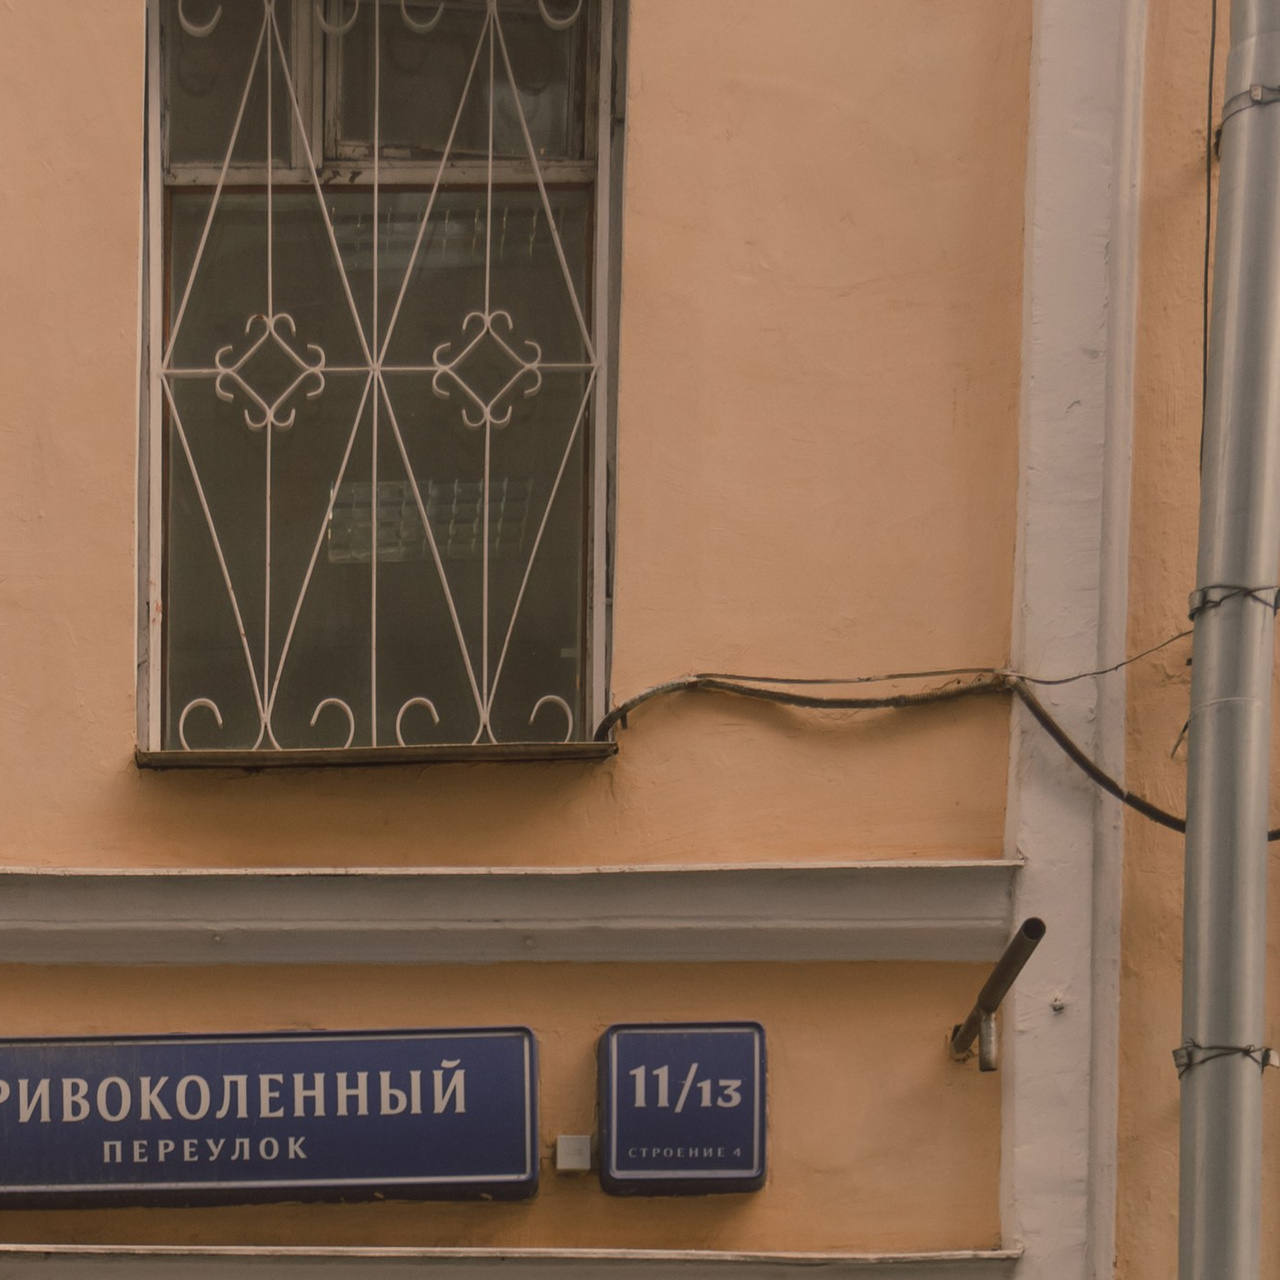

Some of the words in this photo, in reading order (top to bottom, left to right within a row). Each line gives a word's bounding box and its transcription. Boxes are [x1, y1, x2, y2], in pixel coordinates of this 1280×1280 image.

[628, 1062, 742, 1114] 11/13
[102, 1136, 308, 1163] ПЕРЕУЛОК
[627, 1147, 726, 1158] СТРОЕНИЕ
[732, 1147, 742, 1158] 4
